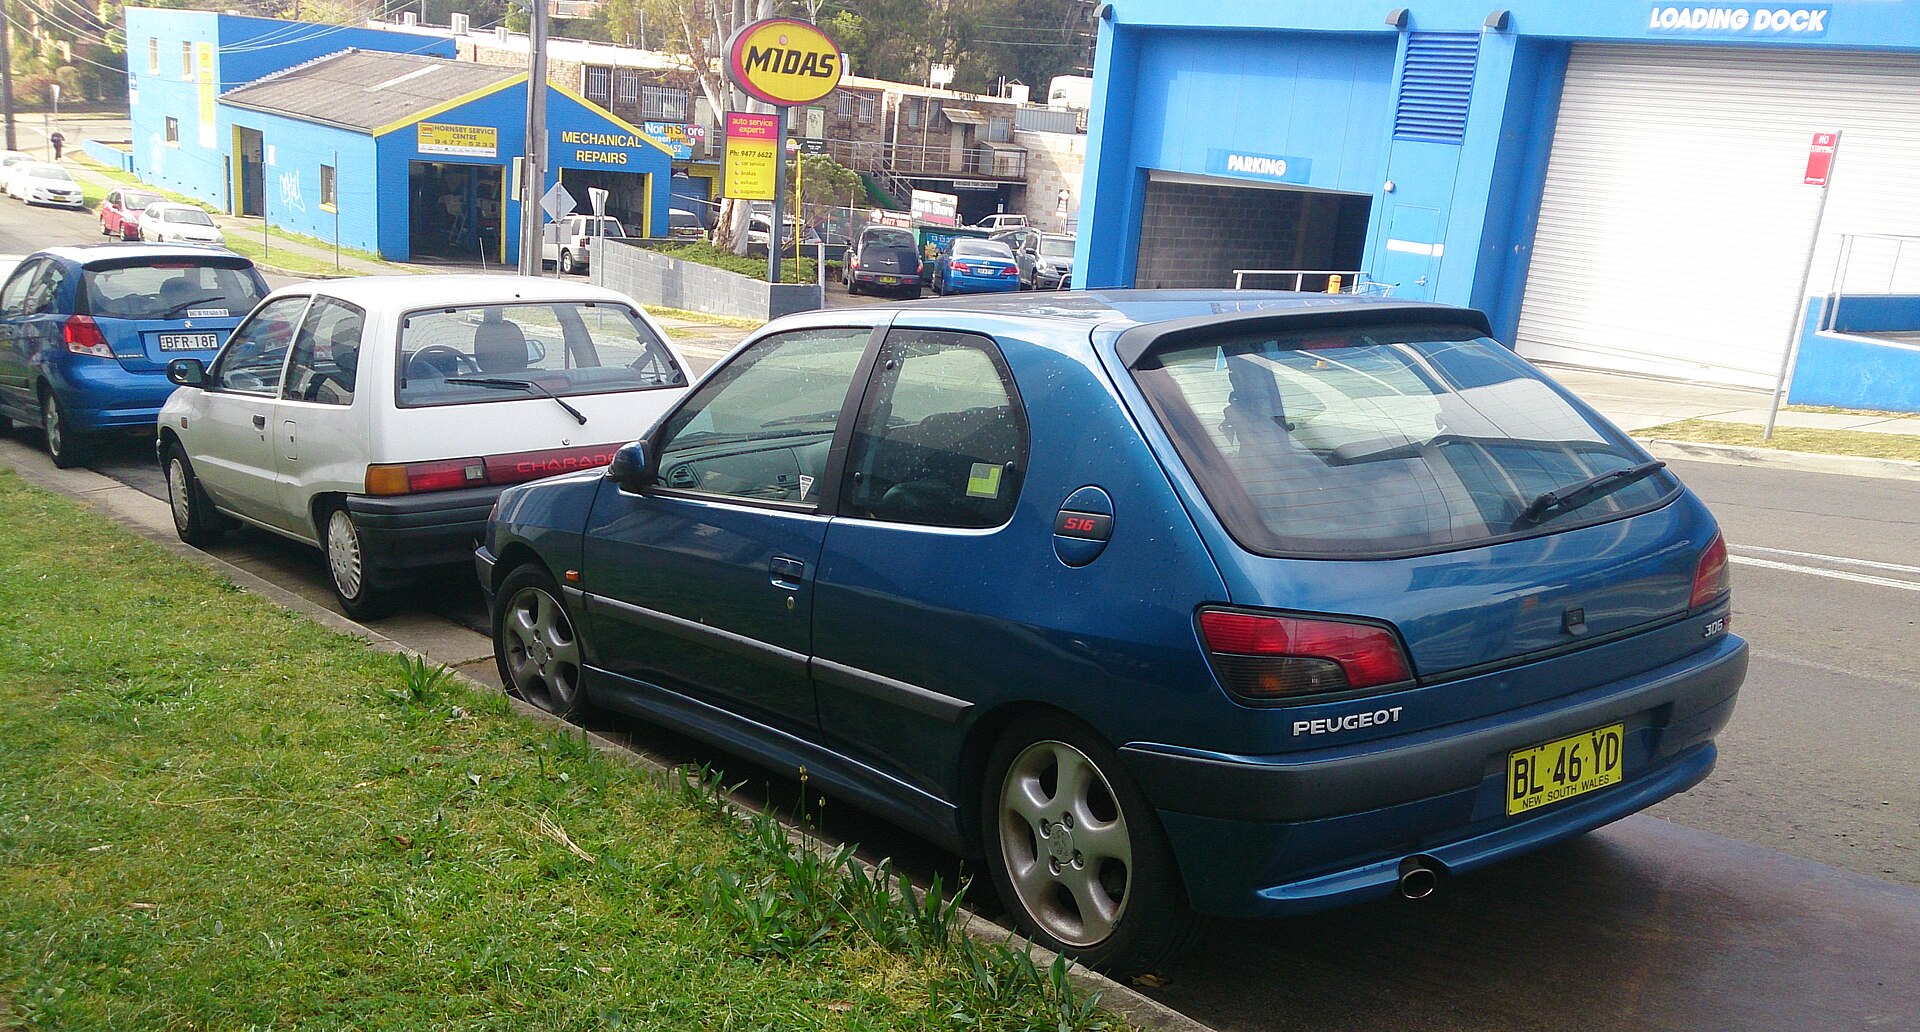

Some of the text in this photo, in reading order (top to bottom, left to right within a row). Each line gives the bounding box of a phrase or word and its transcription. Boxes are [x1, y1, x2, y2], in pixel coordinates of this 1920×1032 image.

[1650, 7, 1828, 32] LOADING DOCK
[745, 46, 835, 78] MIDAS
[434, 125, 467, 133] HORNSBY
[645, 122, 673, 134] North
[749, 118, 773, 127] service
[739, 126, 766, 135] experts
[561, 131, 642, 148] MECHANICAL
[1818, 134, 1830, 144] NO
[576, 150, 627, 164] REPAIRS
[1227, 154, 1287, 177] PARKING
[165, 335, 216, 348] BFR-18F
[1063, 517, 1095, 531] S16
[1705, 618, 1723, 638] 306
[1293, 706, 1403, 736] PEUGEOT
[1522, 774, 1609, 809] NEW SOUTH WALES
